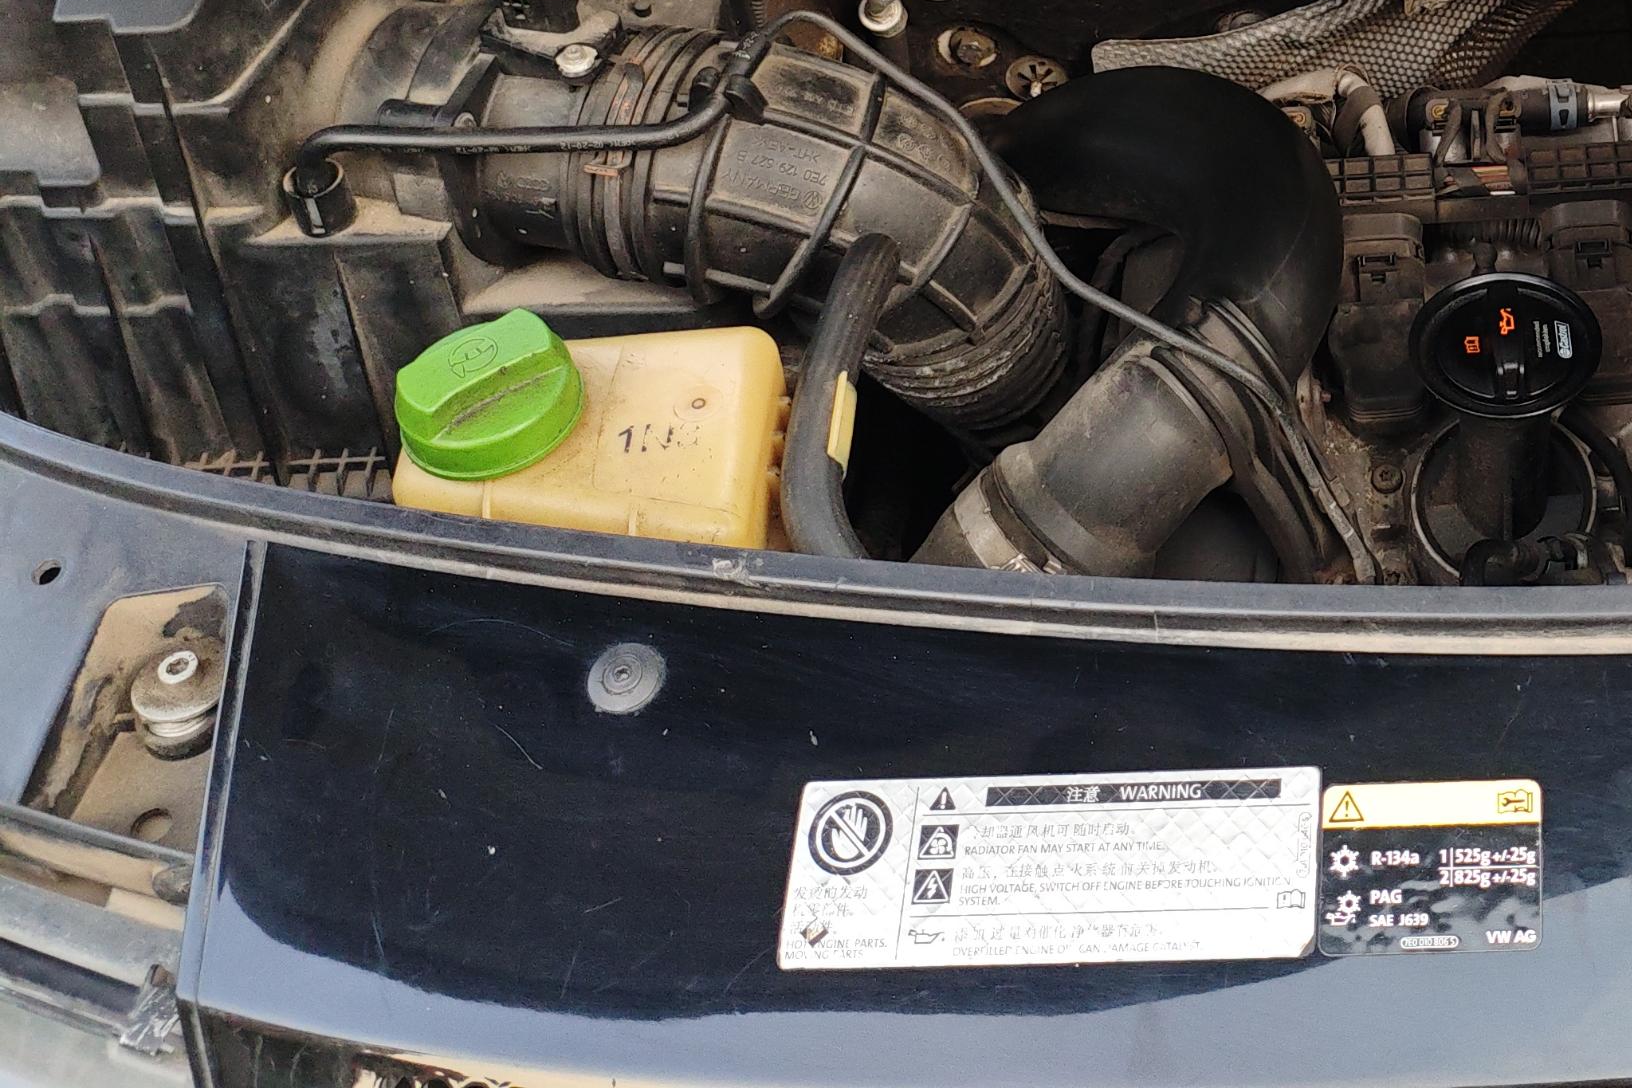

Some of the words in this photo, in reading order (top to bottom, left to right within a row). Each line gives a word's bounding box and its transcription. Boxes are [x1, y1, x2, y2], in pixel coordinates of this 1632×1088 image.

[1558, 324, 1569, 349] Castrol
[1066, 786, 1101, 803] 注意
[1119, 783, 1202, 800] WARNING
[964, 845, 1015, 856] RADIATOR
[1017, 844, 1037, 854] FAN
[1040, 844, 1063, 854] MAY
[1065, 843, 1096, 853] START
[1098, 843, 1111, 852] AT
[1113, 842, 1134, 852] ANY
[1371, 849, 1420, 865] R-134a
[1439, 849, 1447, 864] 1
[1440, 871, 1449, 885] 2
[960, 884, 986, 894] HIGH
[989, 883, 1038, 894] VOLTAGE,
[1039, 882, 1080, 892] SWITCH
[1081, 882, 1101, 891] OFF
[1103, 880, 1142, 890] ENGINE
[1145, 879, 1183, 890] BEFORE
[1185, 878, 1241, 888] TOUCHING
[1244, 877, 1291, 887] IGNITION
[958, 896, 1000, 906] SYSTEM.
[1369, 889, 1403, 905] PAG
[1369, 914, 1394, 927] SAE
[1398, 913, 1429, 926] J639
[811, 938, 851, 950] NGINE
[855, 938, 888, 948] PARTS.
[1486, 931, 1514, 944] VW
[1514, 930, 1537, 943] AG
[1103, 942, 1149, 953] AMAGE
